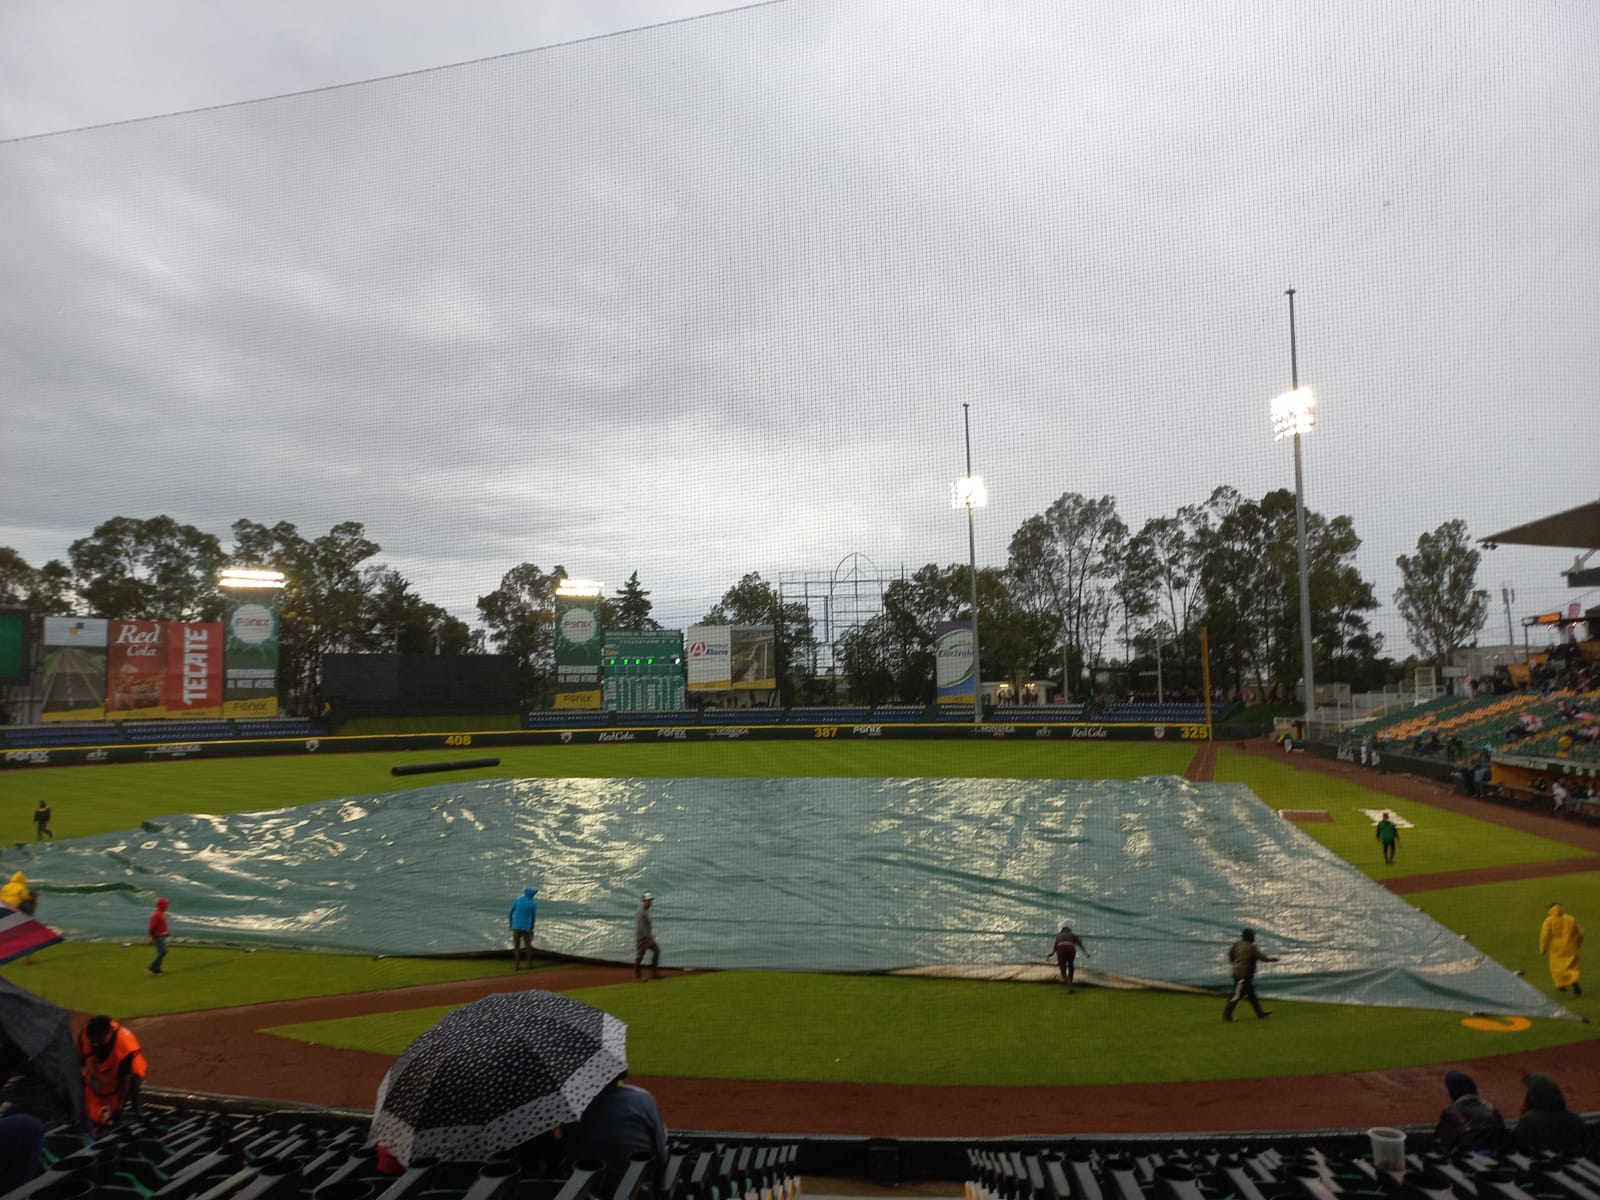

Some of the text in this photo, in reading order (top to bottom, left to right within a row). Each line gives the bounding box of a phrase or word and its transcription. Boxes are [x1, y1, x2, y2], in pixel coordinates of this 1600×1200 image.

[116, 623, 160, 644] Red
[127, 645, 158, 656] Cola
[183, 626, 208, 706] TECATE
[815, 727, 838, 738] 387
[1181, 726, 1208, 739] 325
[445, 735, 472, 747] 408
